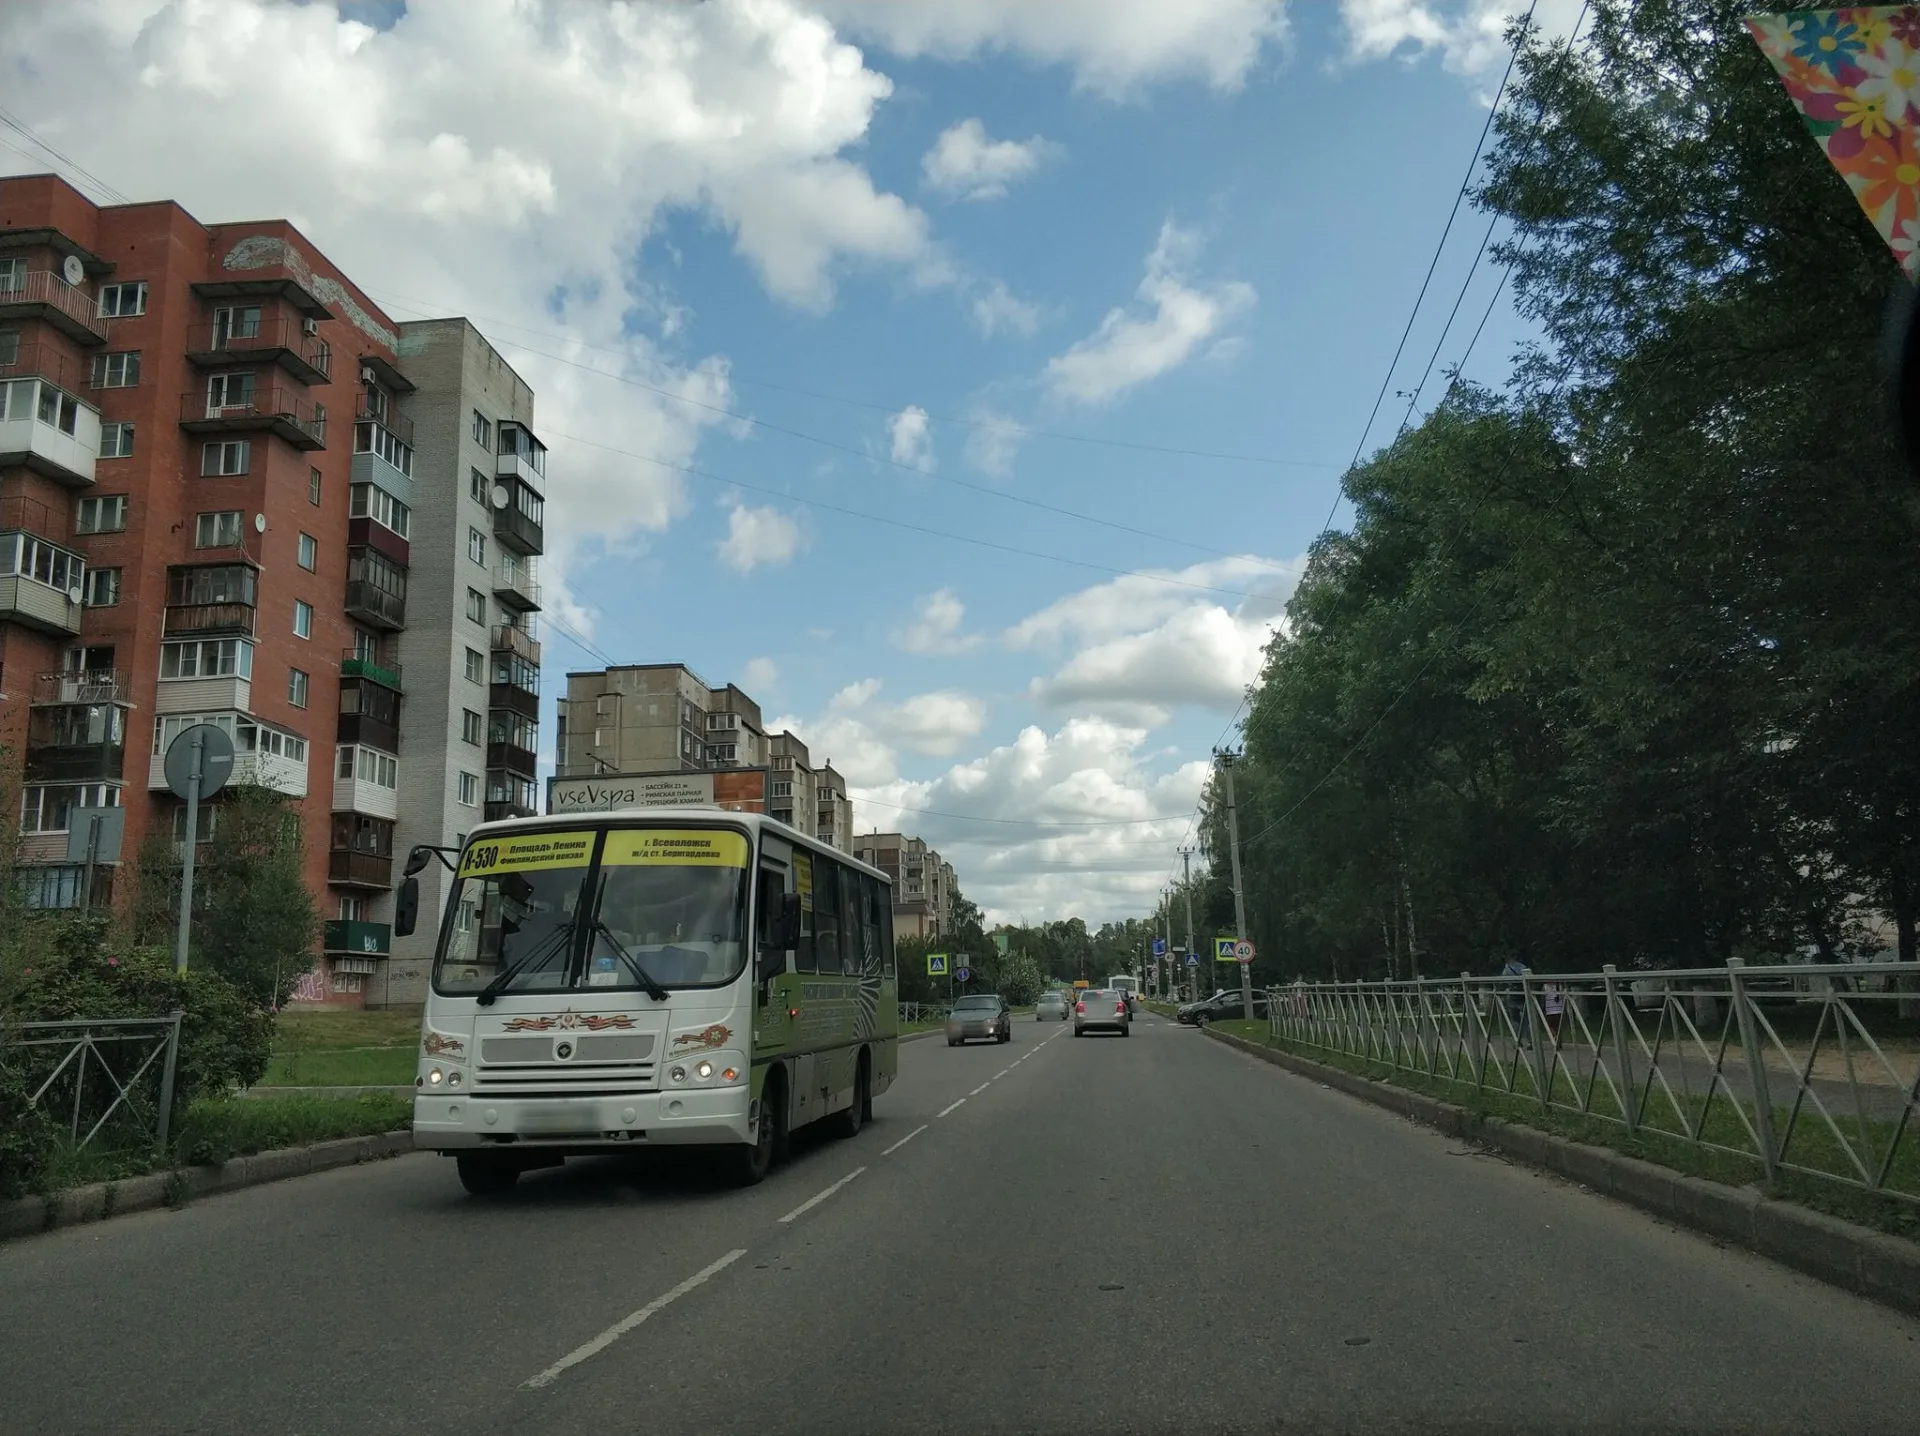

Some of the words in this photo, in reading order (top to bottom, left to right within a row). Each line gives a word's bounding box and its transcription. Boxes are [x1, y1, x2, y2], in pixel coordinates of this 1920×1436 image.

[645, 782, 674, 790] БАССЕЙН
[558, 784, 635, 811] vseVspa
[509, 843, 552, 854] Площадь
[552, 840, 587, 851] Ленина
[652, 838, 712, 848] Всеволожск
[499, 852, 555, 865] Финляндский
[555, 852, 585, 861] вокзал
[1238, 946, 1251, 956] 40
